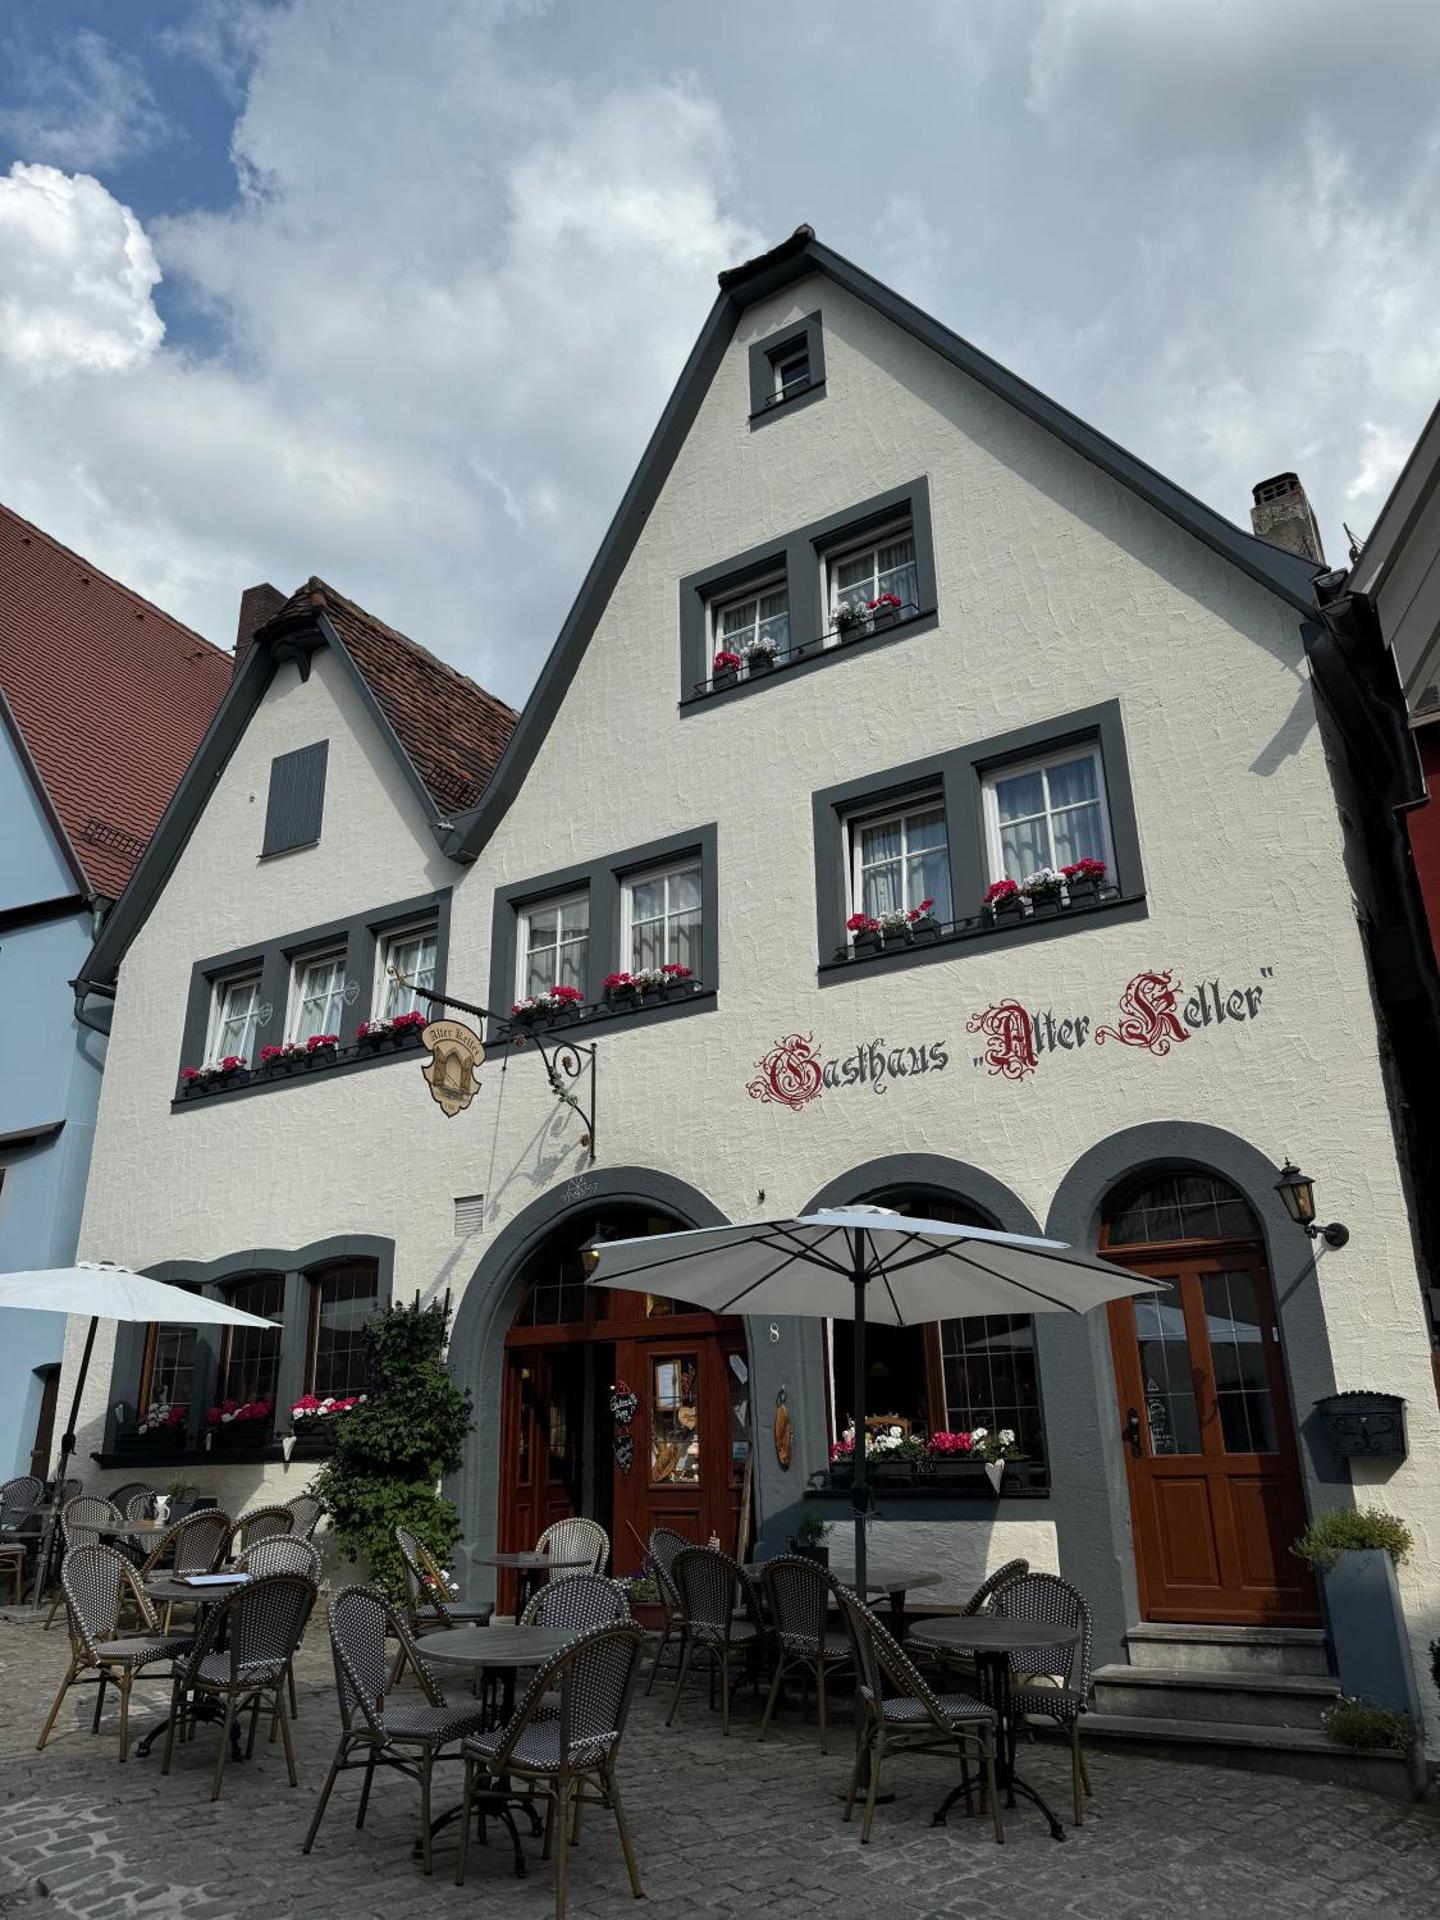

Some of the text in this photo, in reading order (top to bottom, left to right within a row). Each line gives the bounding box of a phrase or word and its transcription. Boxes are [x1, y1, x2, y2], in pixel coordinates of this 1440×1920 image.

[428, 1027, 481, 1056] Alter Keller
[746, 1031, 949, 1111] Gasthaus
[770, 1322, 779, 1342] 8
